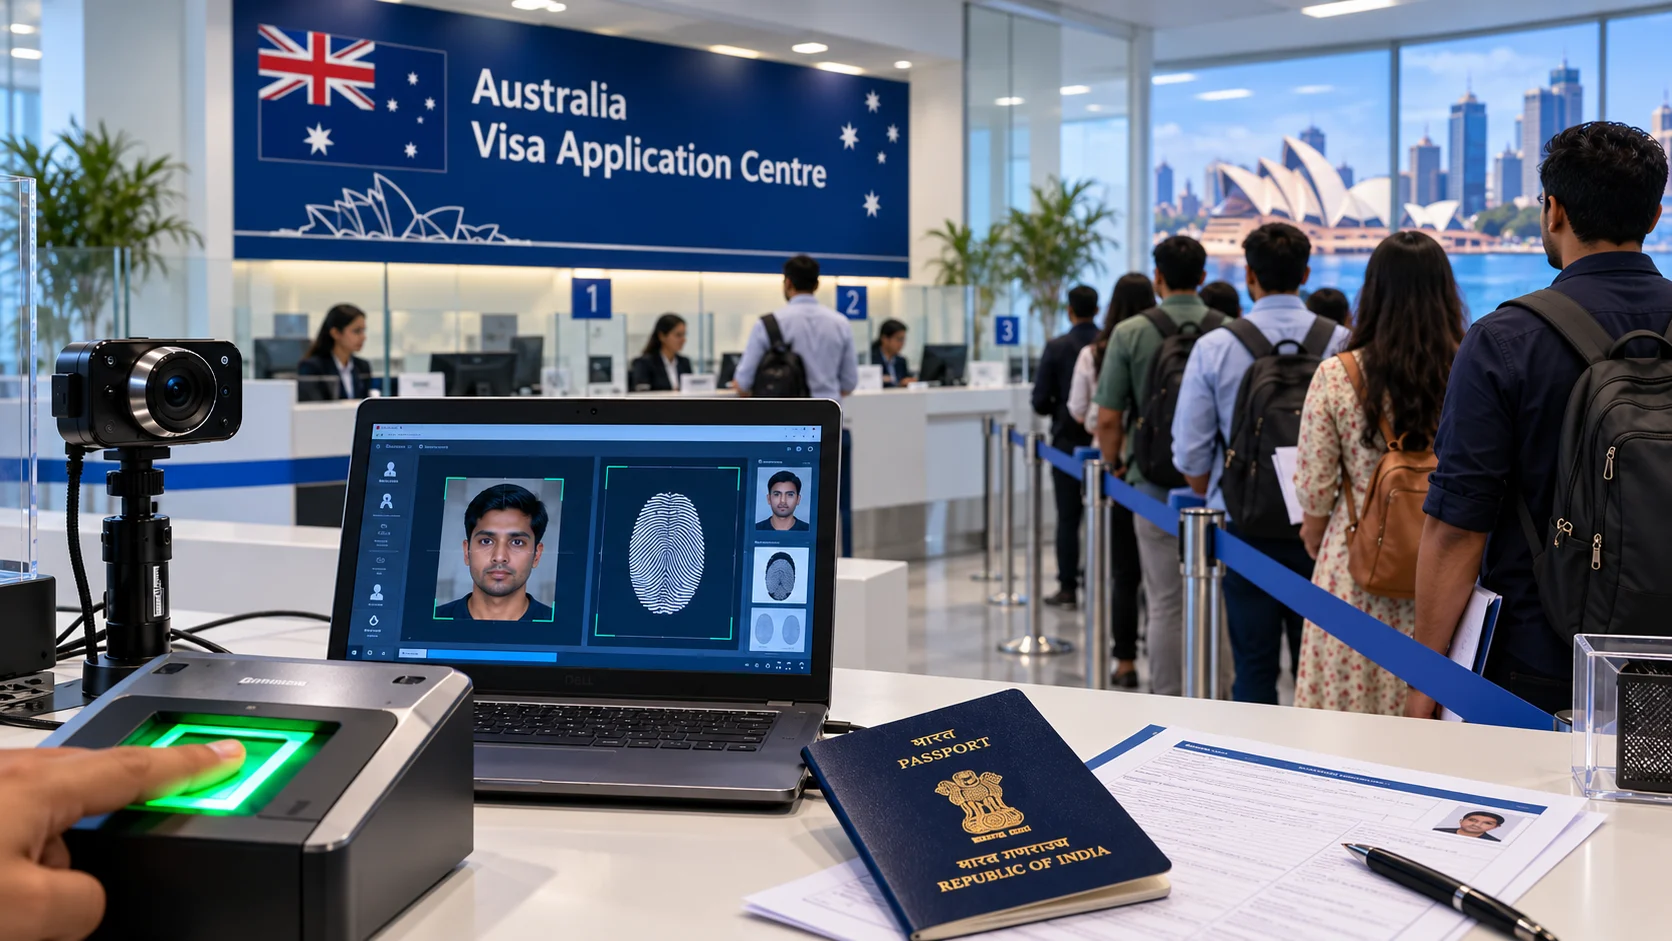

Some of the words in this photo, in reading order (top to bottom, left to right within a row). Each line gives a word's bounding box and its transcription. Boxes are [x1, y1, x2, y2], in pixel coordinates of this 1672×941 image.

[471, 68, 627, 121] Australia
[471, 121, 546, 163] Visa
[556, 130, 732, 179] Application
[740, 150, 827, 188] Centre
[586, 284, 598, 312] 1
[846, 289, 860, 315] 2
[1002, 319, 1014, 342] 3
[898, 736, 991, 769] PASSPORT
[911, 729, 956, 747] भारत
[937, 864, 1026, 892] REPUBLIC
[1029, 857, 1052, 871] OF
[1056, 845, 1112, 865] INDIA
